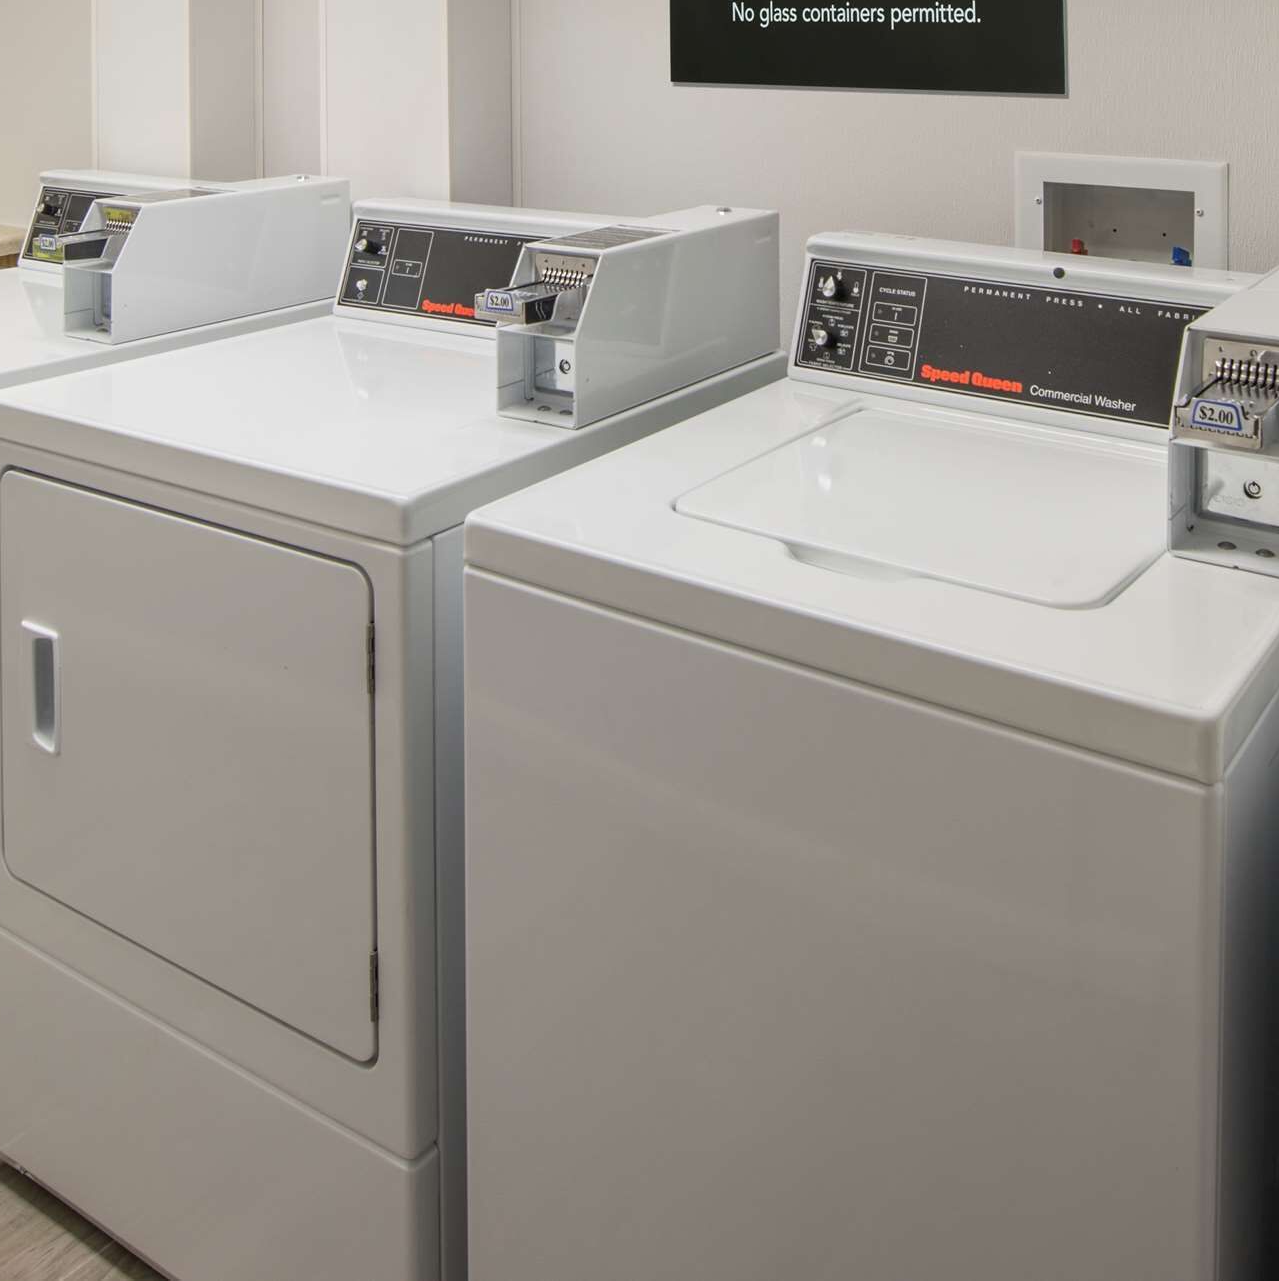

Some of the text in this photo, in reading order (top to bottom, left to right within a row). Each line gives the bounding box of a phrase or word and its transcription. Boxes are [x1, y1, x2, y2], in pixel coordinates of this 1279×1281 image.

[732, 0, 981, 30] No glass containers permitted.
[464, 236, 508, 244] PERMANENT
[422, 299, 475, 316] Speed Que
[489, 294, 509, 306] $2.00
[964, 286, 1197, 320] PERMANENT PRESS ALL FABRI
[921, 365, 1136, 411] Speed Queen Commercial Washer
[1200, 406, 1233, 424] $2.00
